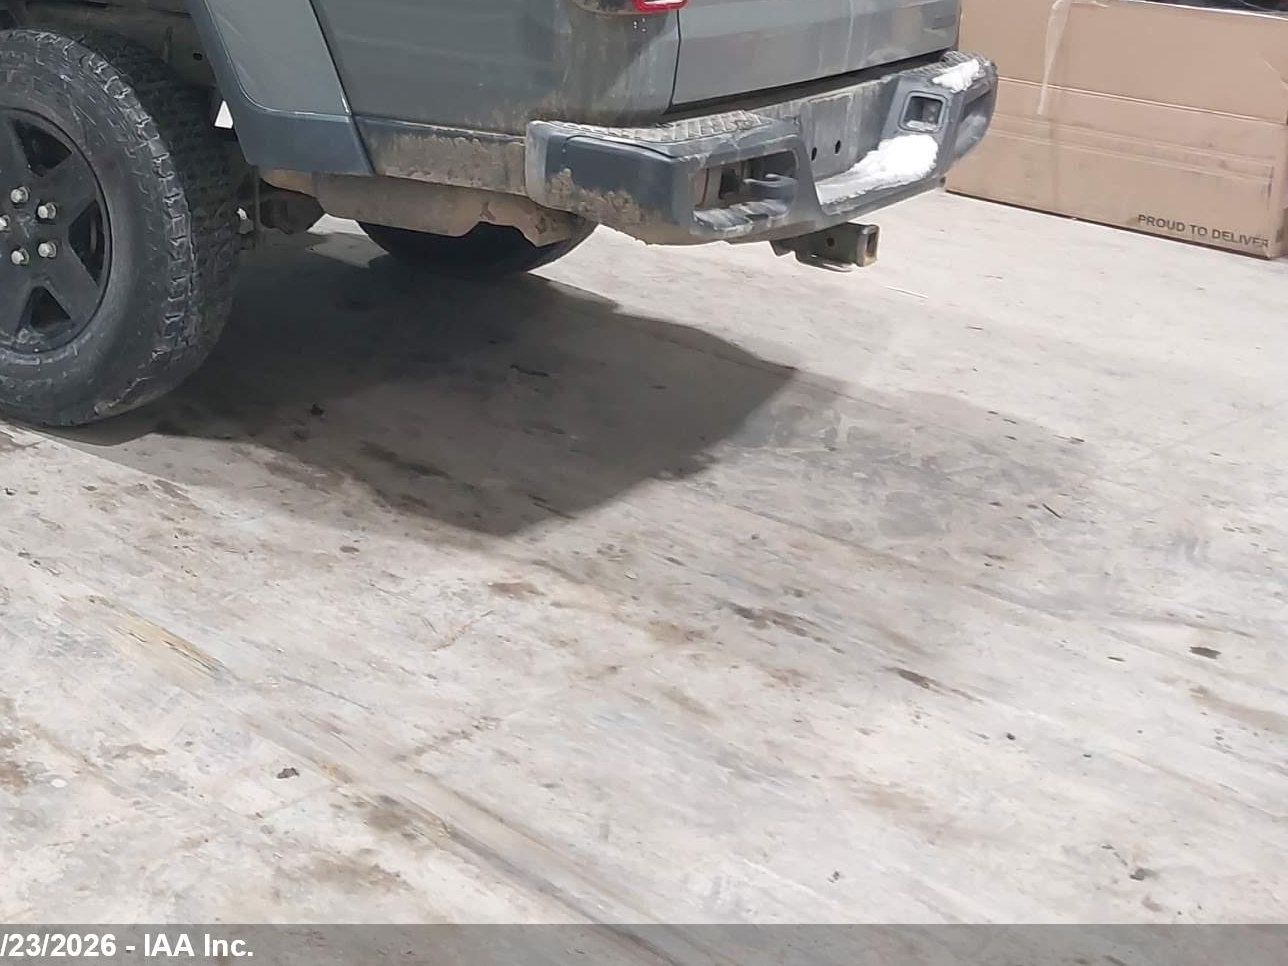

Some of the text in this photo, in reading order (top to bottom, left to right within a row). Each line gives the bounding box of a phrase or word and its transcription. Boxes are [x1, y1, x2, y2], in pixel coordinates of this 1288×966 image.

[1138, 214, 1269, 248] PROUD TO DELIVER
